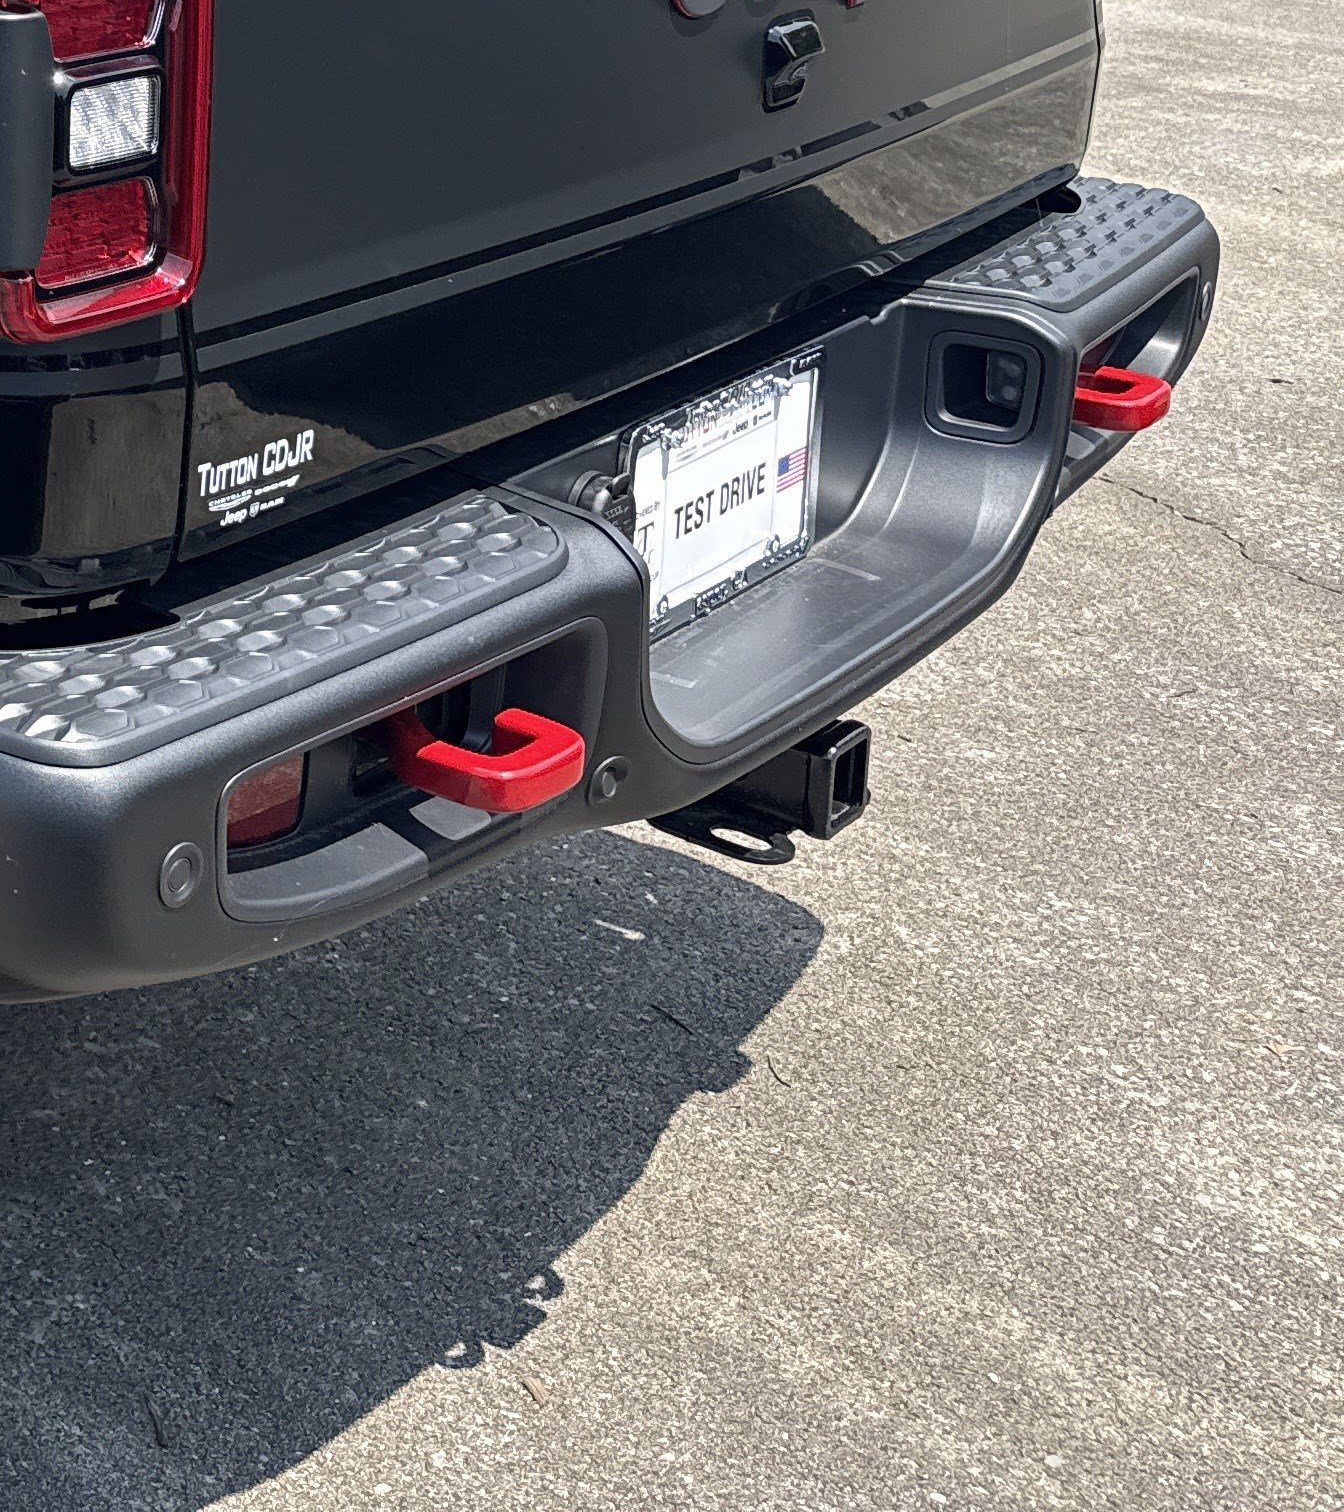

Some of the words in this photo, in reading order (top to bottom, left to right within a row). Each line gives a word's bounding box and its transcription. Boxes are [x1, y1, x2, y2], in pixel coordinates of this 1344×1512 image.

[197, 453, 259, 497] TUTTON
[262, 429, 315, 476] CDJR
[220, 508, 248, 527] Jeep
[673, 490, 715, 540] TEST
[719, 461, 767, 516] DRIVE
